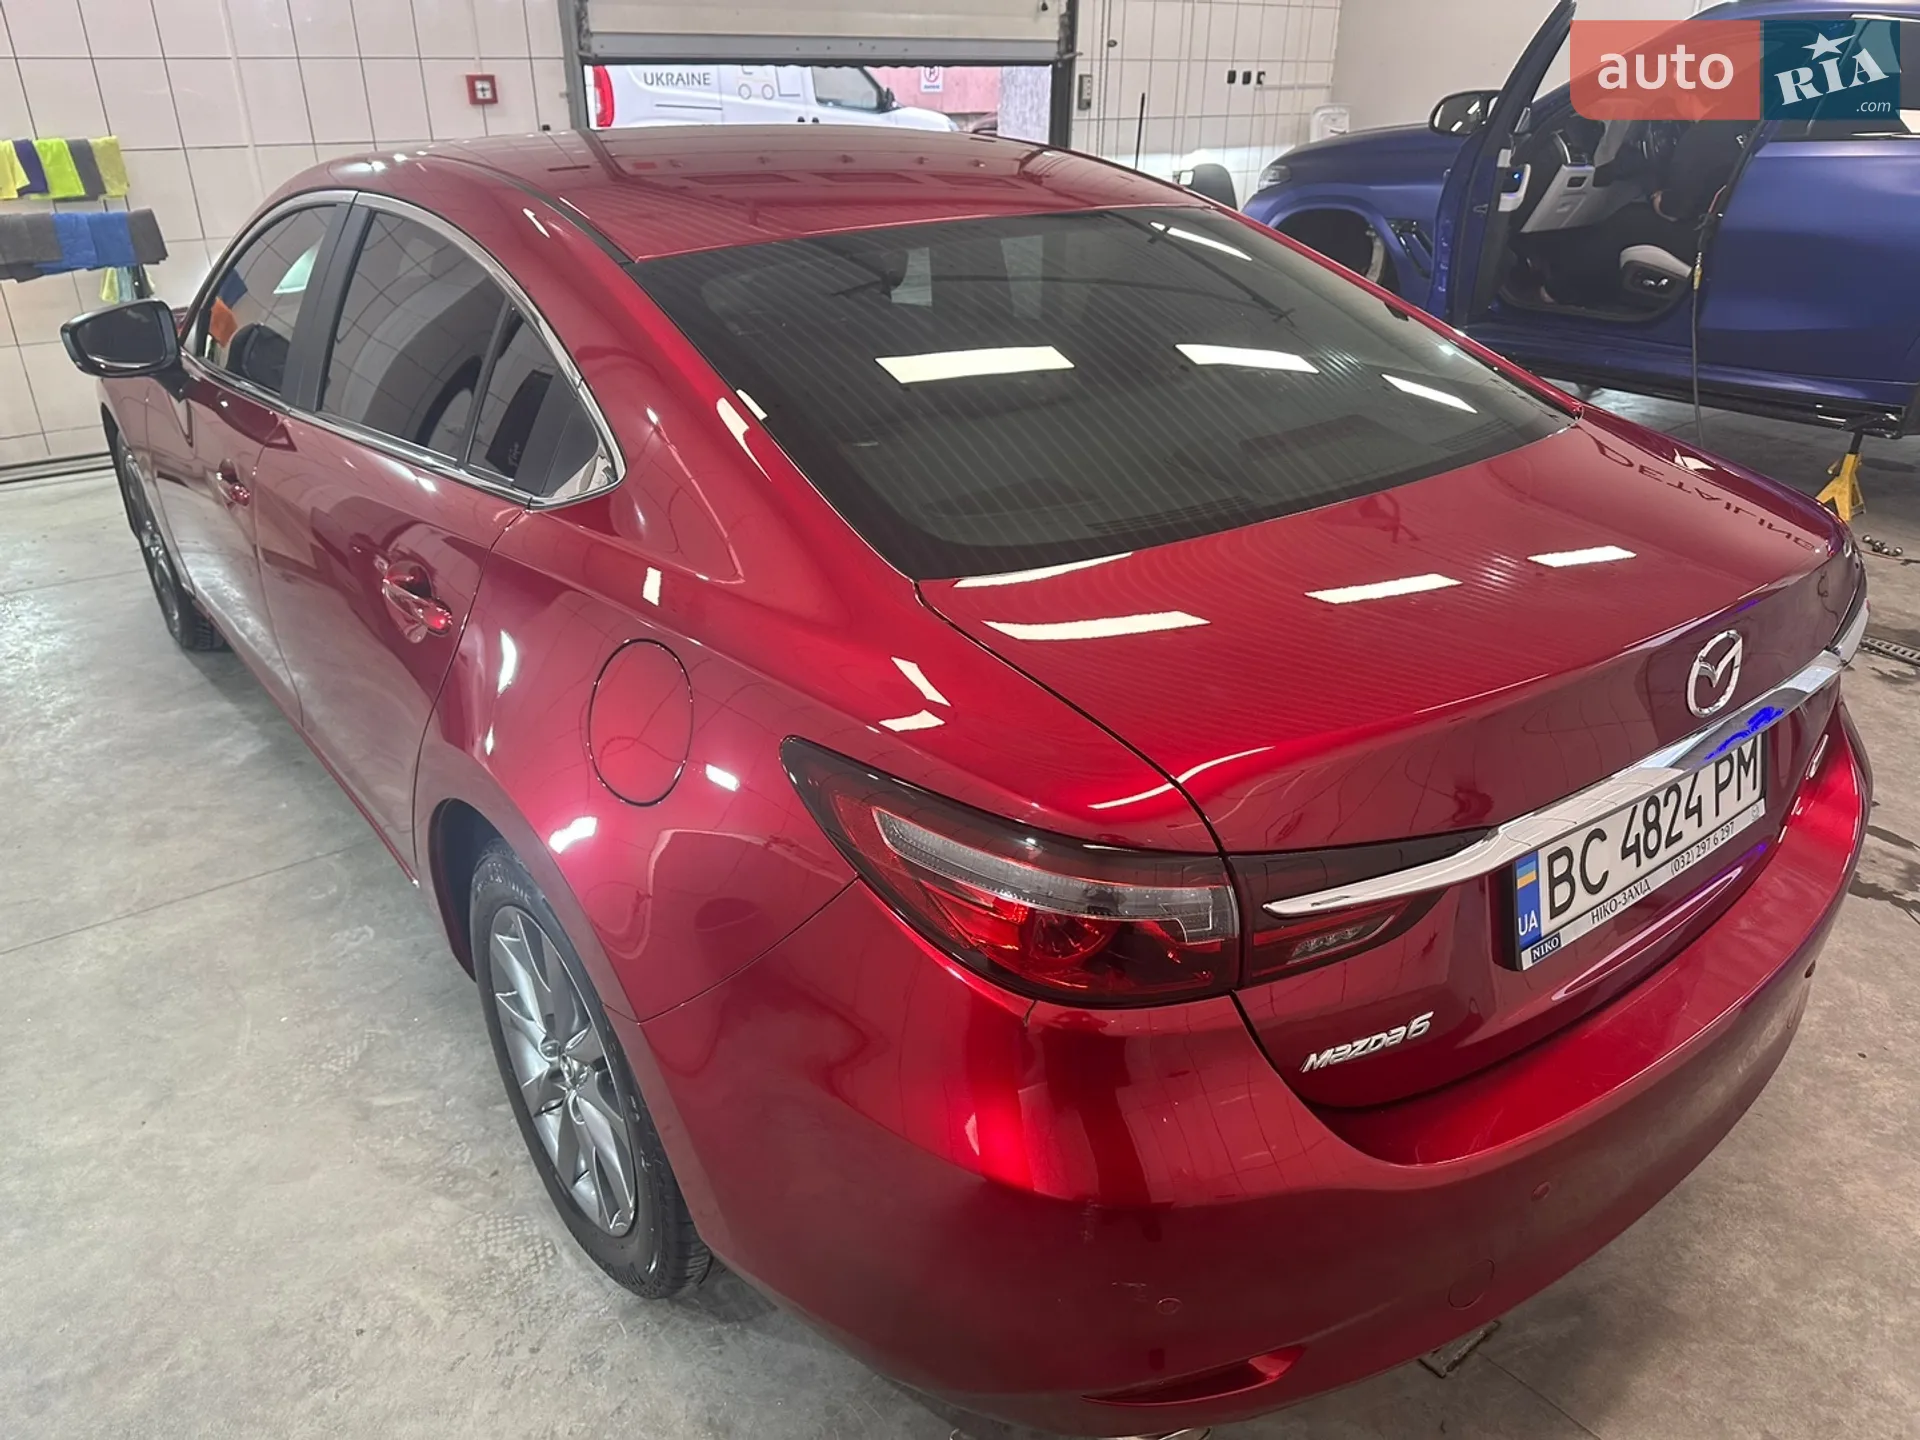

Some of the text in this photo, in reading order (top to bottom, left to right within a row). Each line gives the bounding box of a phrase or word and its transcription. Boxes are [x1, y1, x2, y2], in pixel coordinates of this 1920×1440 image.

[643, 72, 712, 86] UKRAINE
[1547, 736, 1757, 920] BC 4824 PM
[1670, 848, 1695, 876] (032)
[1696, 837, 1711, 859] 297
[1713, 832, 1719, 846] 6
[1720, 821, 1735, 842] 297
[1518, 910, 1538, 936] UA
[1532, 936, 1560, 961] NIKO
